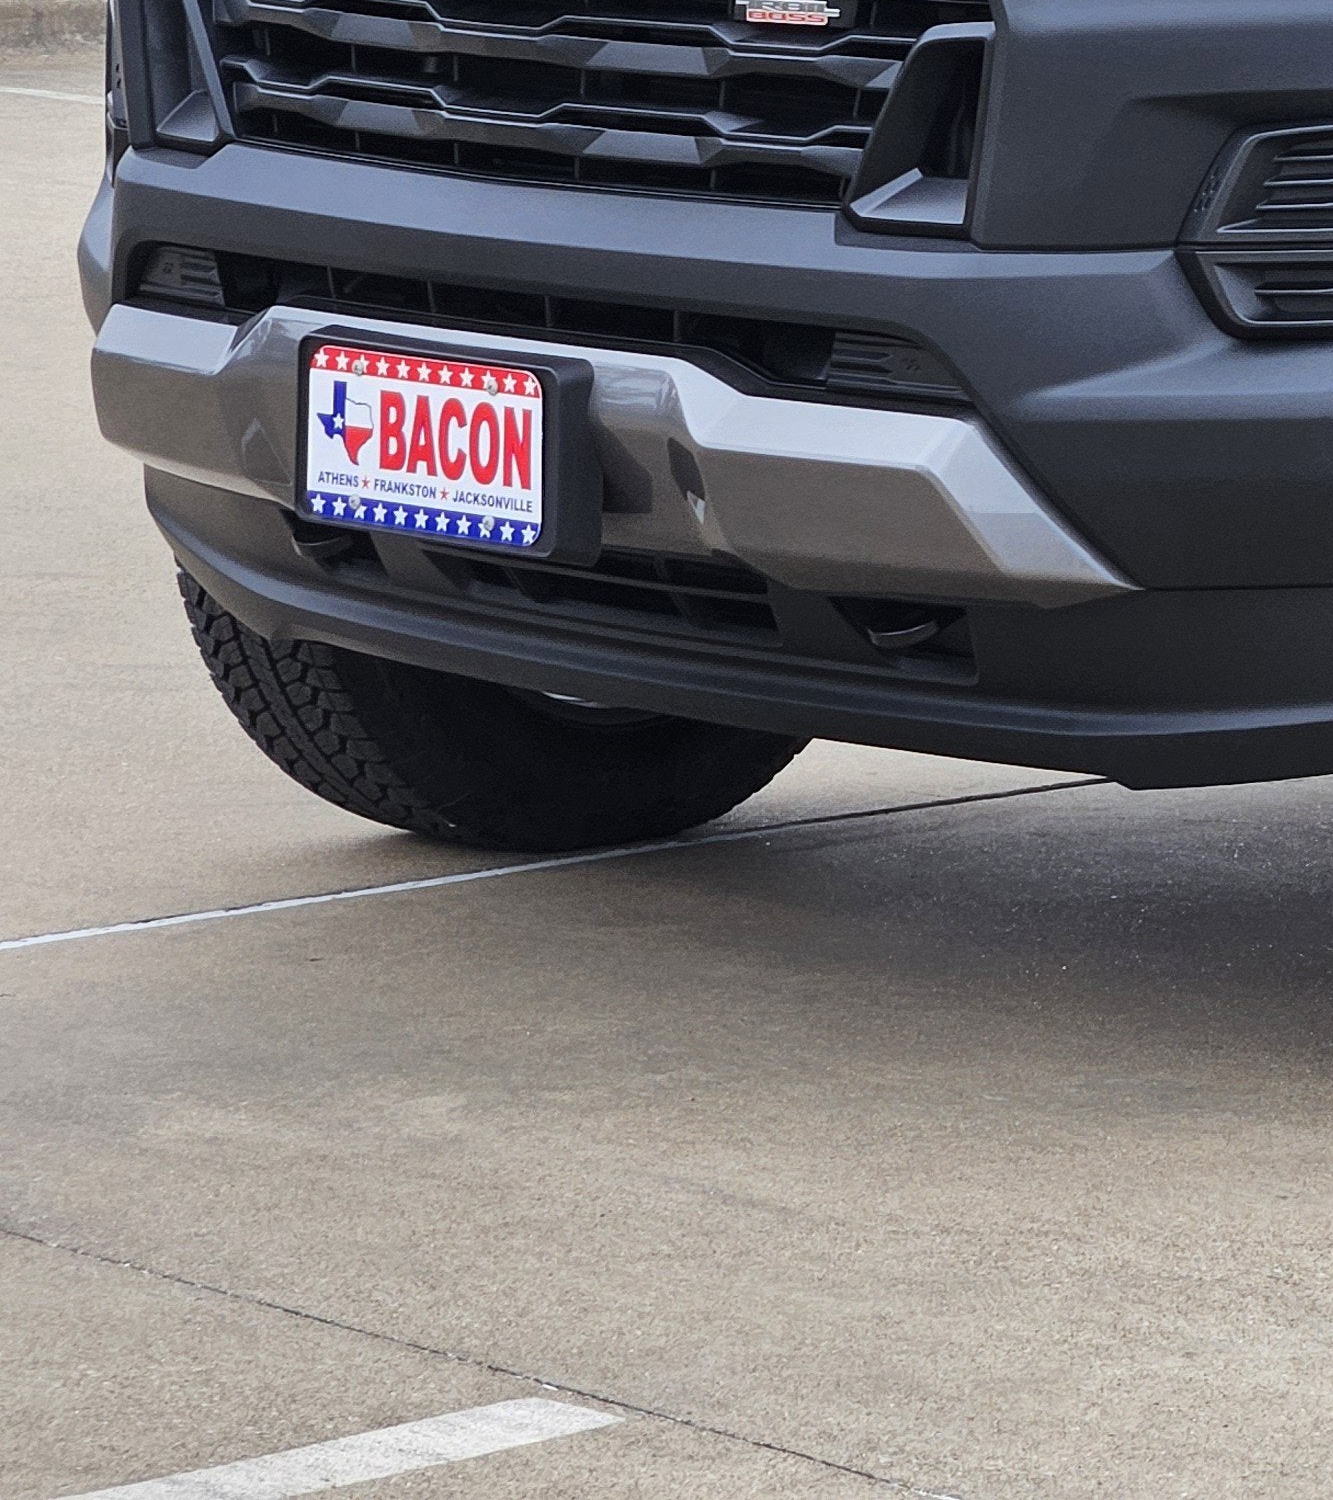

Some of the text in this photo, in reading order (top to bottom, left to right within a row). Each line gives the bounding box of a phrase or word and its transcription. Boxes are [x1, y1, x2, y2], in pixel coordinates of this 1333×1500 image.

[746, 8, 829, 26] BOSS
[379, 389, 533, 491] BACON
[317, 470, 534, 514] ATHENS FRANKSTON JACKSONVILLE
